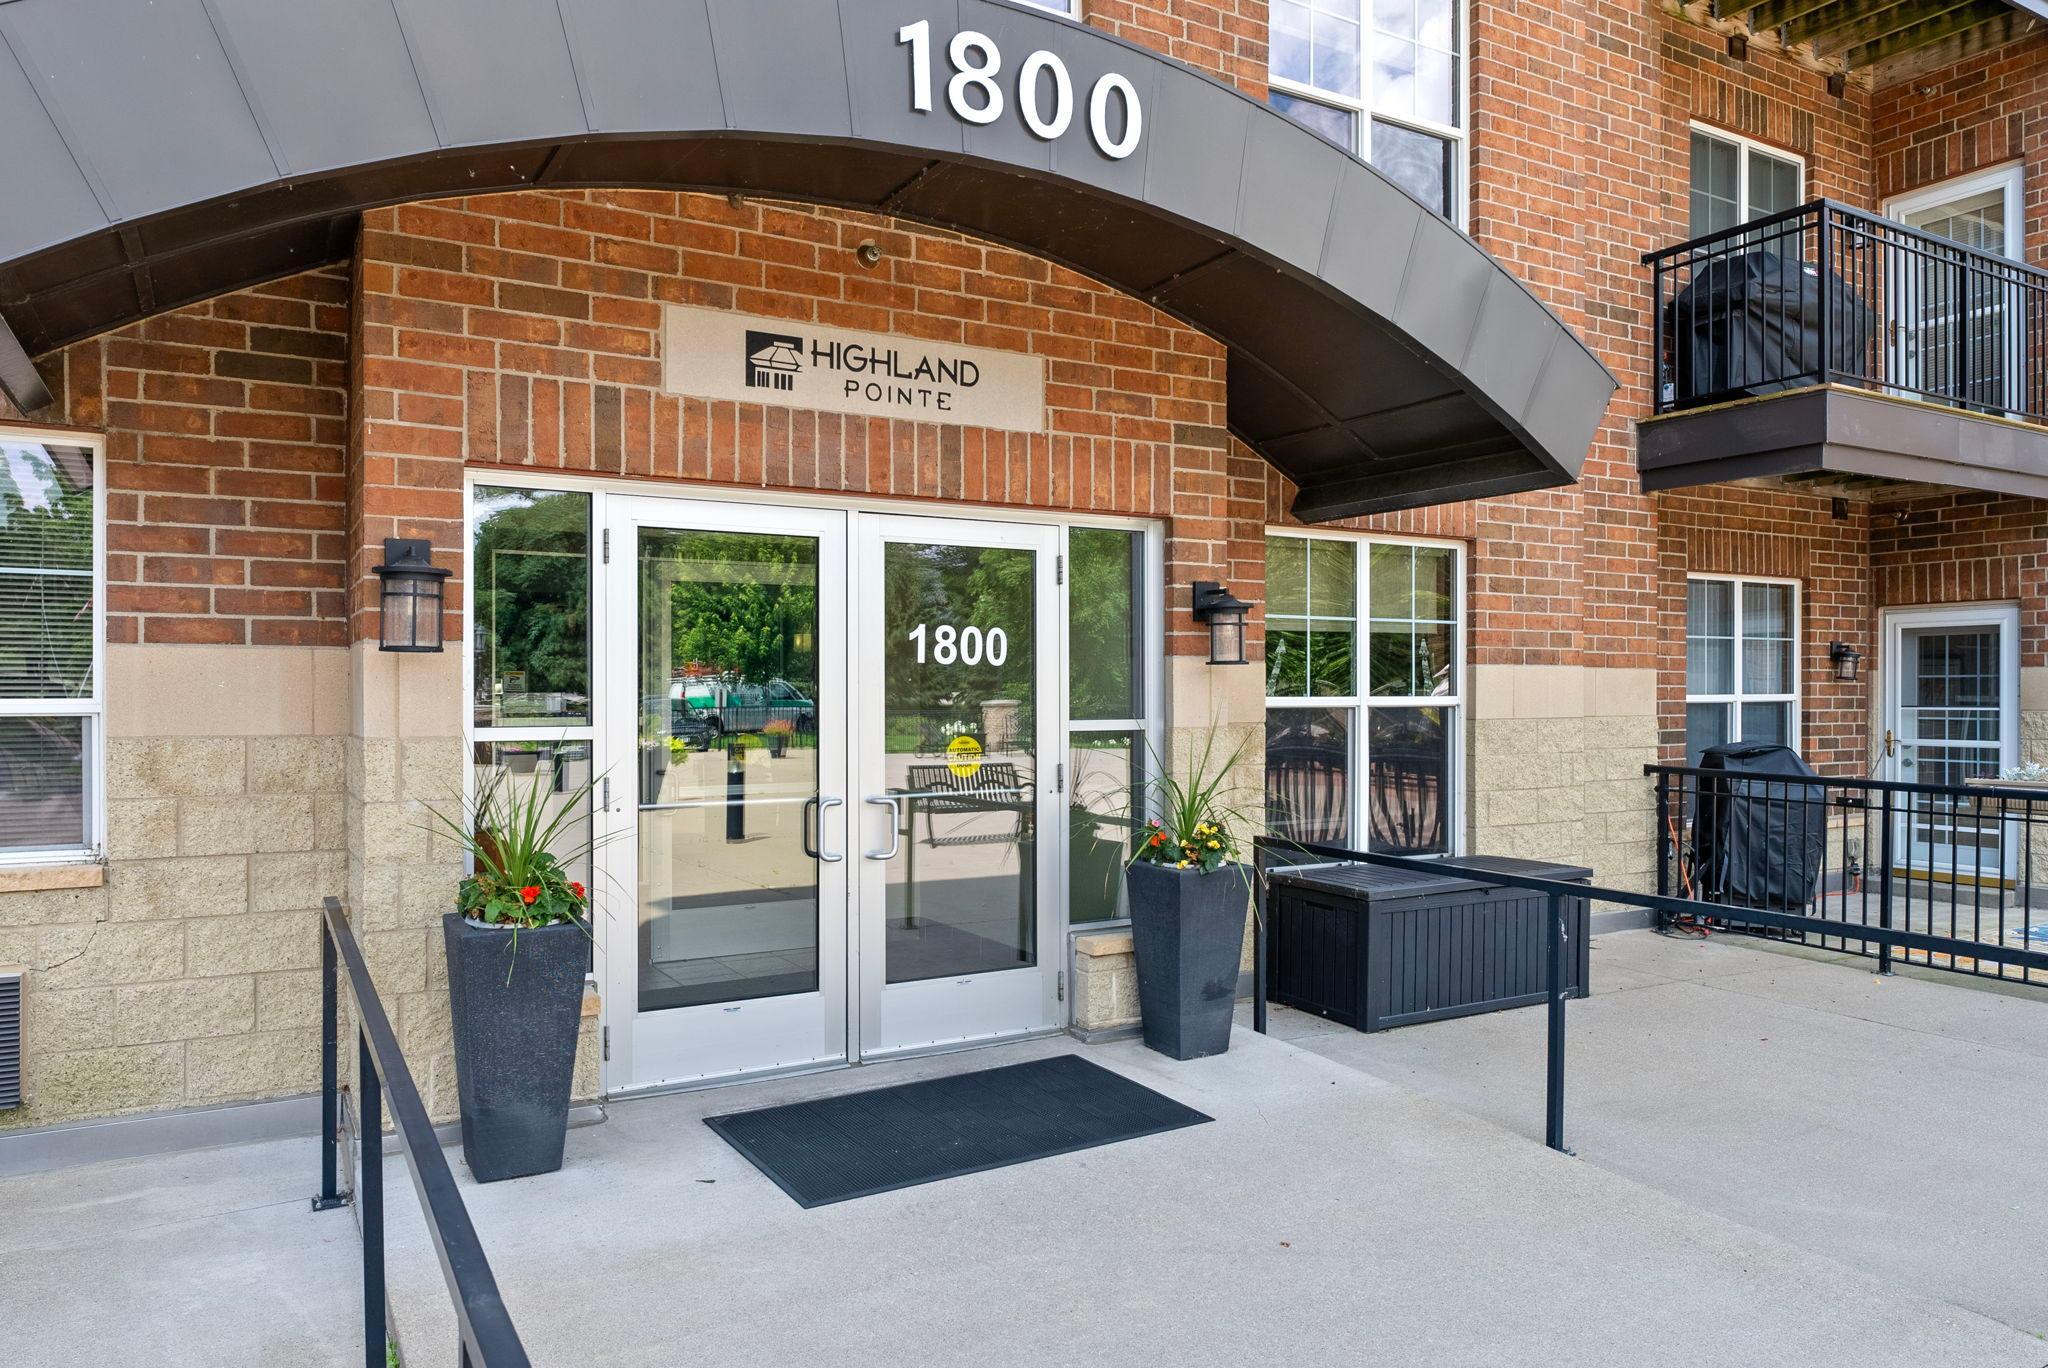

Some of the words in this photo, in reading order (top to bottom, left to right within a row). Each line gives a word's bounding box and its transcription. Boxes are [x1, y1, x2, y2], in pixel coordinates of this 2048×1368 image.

[898, 19, 1143, 159] 1800
[810, 339, 980, 388] HIGHLAND
[844, 379, 952, 411] POINTE
[908, 623, 1008, 667] 1800
